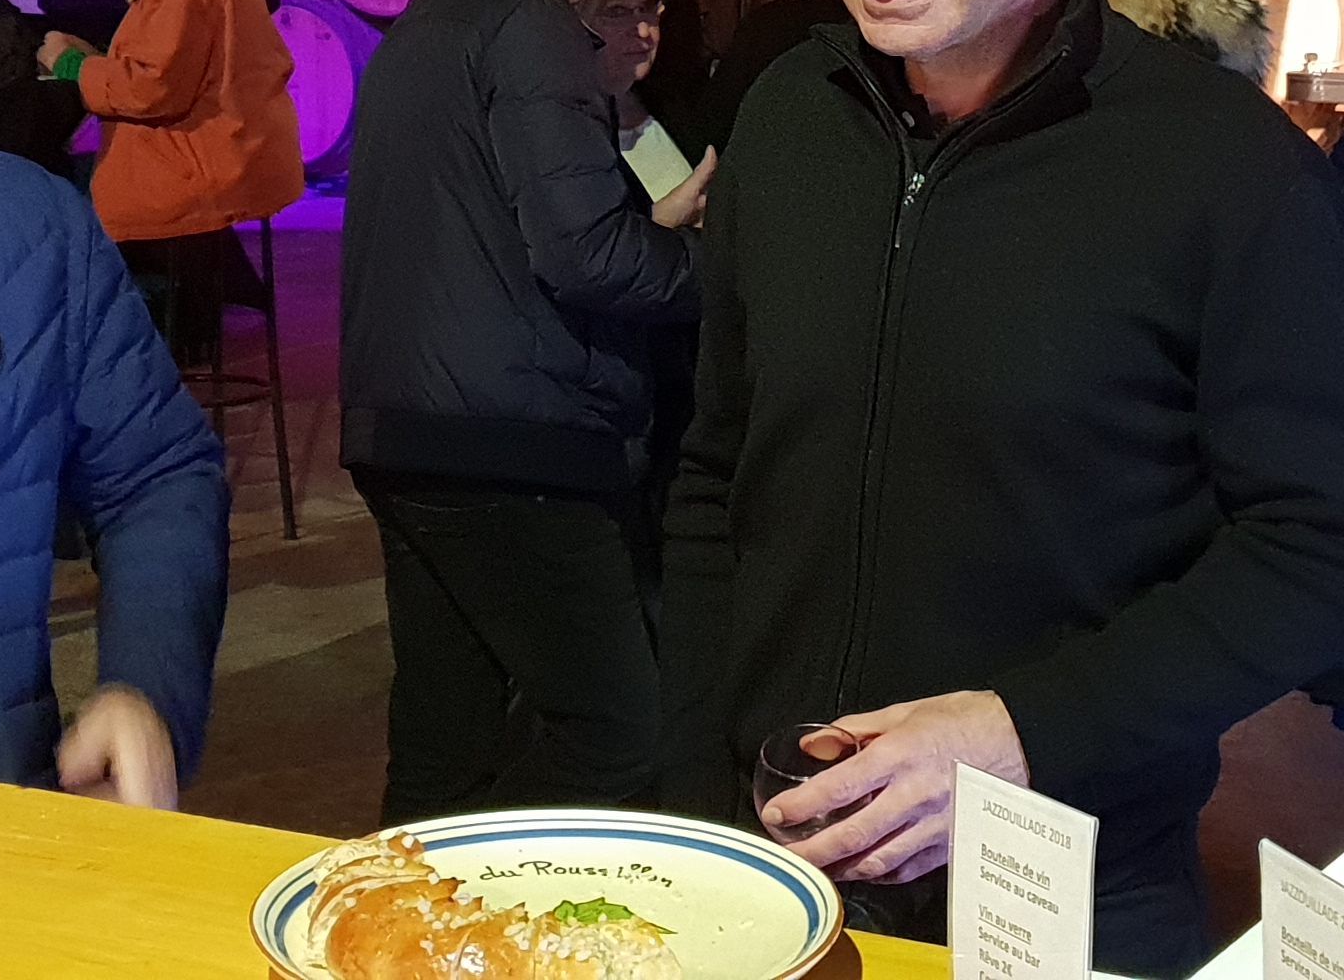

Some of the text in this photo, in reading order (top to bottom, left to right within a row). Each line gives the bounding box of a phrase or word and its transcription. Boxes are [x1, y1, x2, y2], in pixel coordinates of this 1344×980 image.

[982, 799, 1072, 850] JAZZOUILLADE 2018
[480, 865, 522, 881] du
[981, 843, 1051, 887] Bouteille de vin
[979, 865, 1059, 915] Service au caveau
[978, 903, 1032, 942] Vin au verre
[978, 926, 1041, 968] Service au bar
[978, 948, 1000, 970] Rêve
[1001, 960, 1013, 978] 2€
[1319, 951, 1330, 969] de
[1331, 960, 1344, 979] vin
